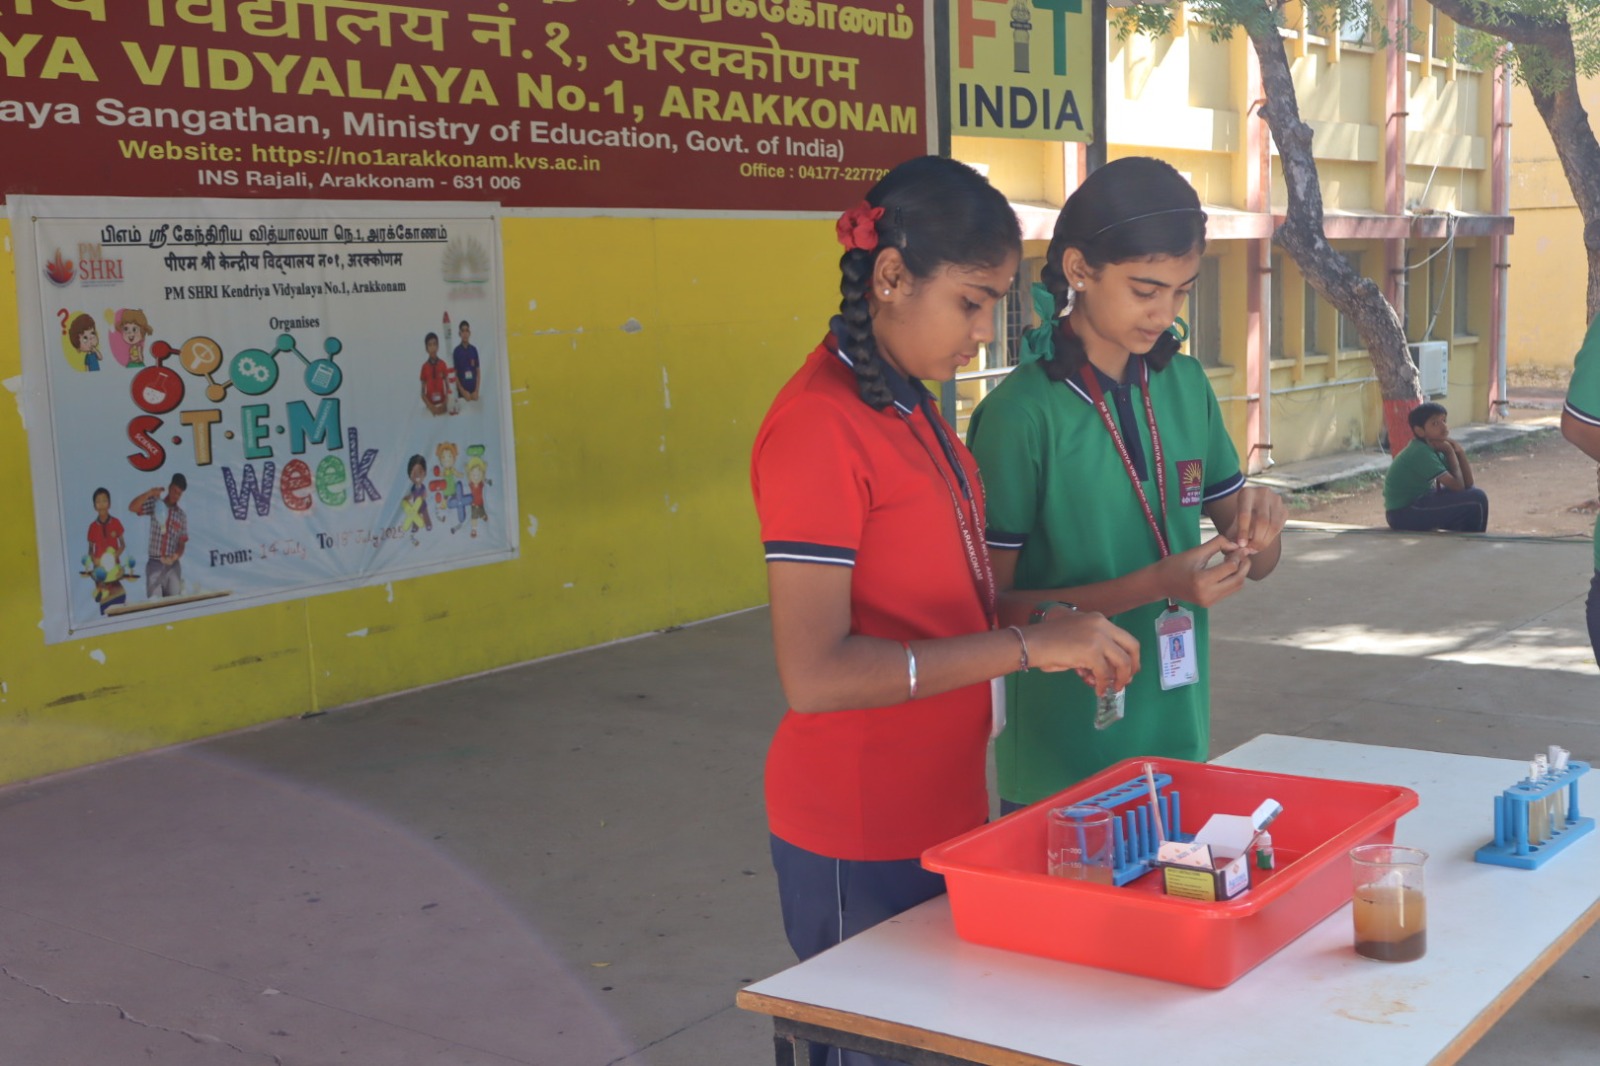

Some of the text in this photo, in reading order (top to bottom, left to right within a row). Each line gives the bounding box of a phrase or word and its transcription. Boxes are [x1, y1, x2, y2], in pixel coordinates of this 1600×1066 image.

[607, 30, 859, 90] अरक्कोणम
[120, 41, 500, 107] VIDYALAYA
[516, 73, 645, 123] No.1,
[659, 85, 918, 135] ARAKKONAM
[959, 83, 1084, 131] INDIA
[96, 99, 331, 139] Sangathan,
[343, 111, 480, 145] Ministry
[490, 120, 521, 143] of
[530, 121, 679, 153] Education,
[685, 131, 750, 154] Govt.
[756, 137, 781, 156] of
[786, 139, 845, 162] India)
[118, 140, 601, 172] Website: https://no1arakkonam.kvs.ac.in
[198, 169, 239, 186] INS
[246, 171, 314, 190] Rajali,
[320, 173, 434, 189] Arakkonam
[453, 175, 484, 189] 631
[489, 176, 521, 190] 006
[739, 162, 785, 178] Office
[79, 259, 124, 280] SHRI
[165, 286, 185, 300] PM
[188, 285, 218, 299] SHRI
[221, 284, 270, 300] Kendriya
[272, 282, 322, 299] Vidyalaya
[351, 281, 406, 294] Arakkonam
[269, 315, 320, 332] Organises
[317, 532, 333, 549] To
[209, 549, 253, 567] From:
[962, 529, 983, 581] ARAKKONAM
